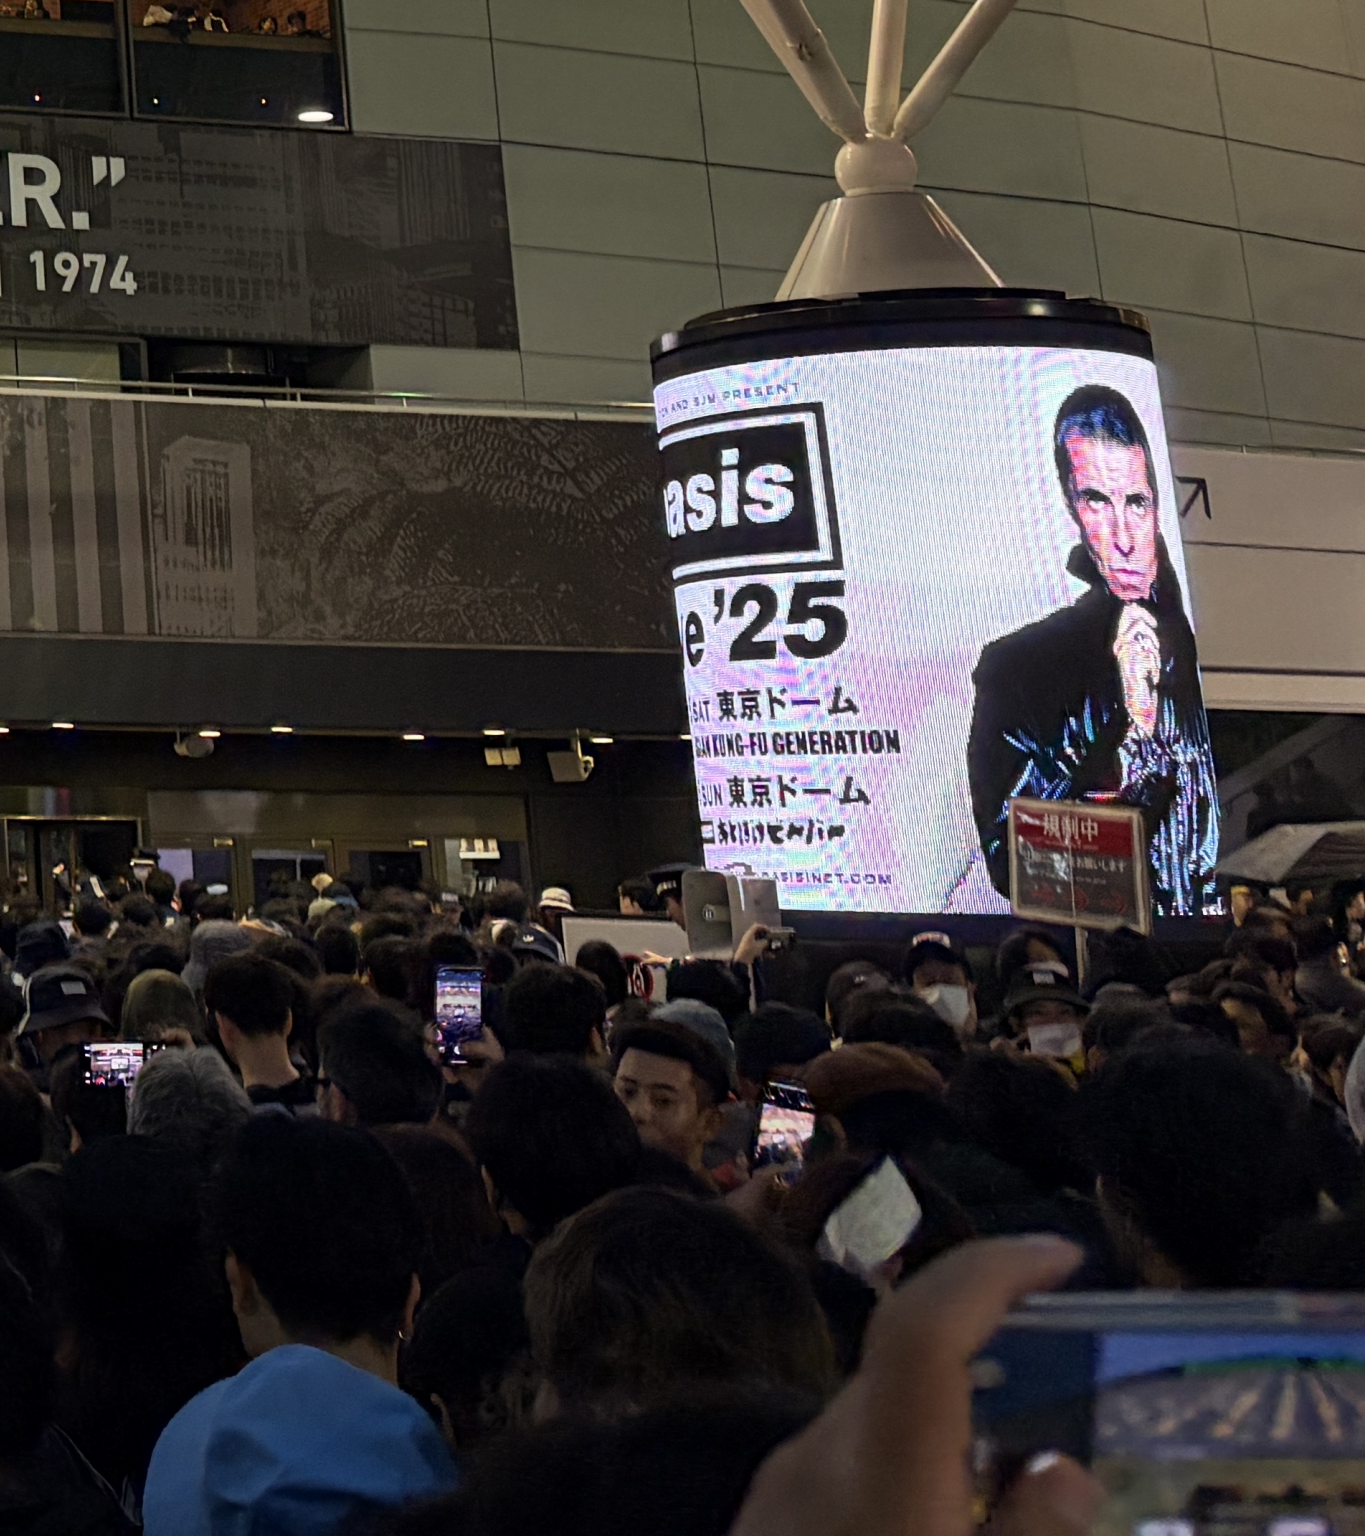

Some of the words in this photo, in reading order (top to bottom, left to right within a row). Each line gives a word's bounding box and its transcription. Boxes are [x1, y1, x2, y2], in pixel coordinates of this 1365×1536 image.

[29, 249, 138, 296] 1974
[722, 382, 800, 402] PRESENT
[663, 448, 795, 538] asis
[714, 580, 848, 662] ’25
[716, 686, 859, 722] 東京ドーム
[711, 732, 769, 758] KUNG-FU
[772, 730, 901, 756] GENERATION
[727, 775, 871, 808] 東京ドーム
